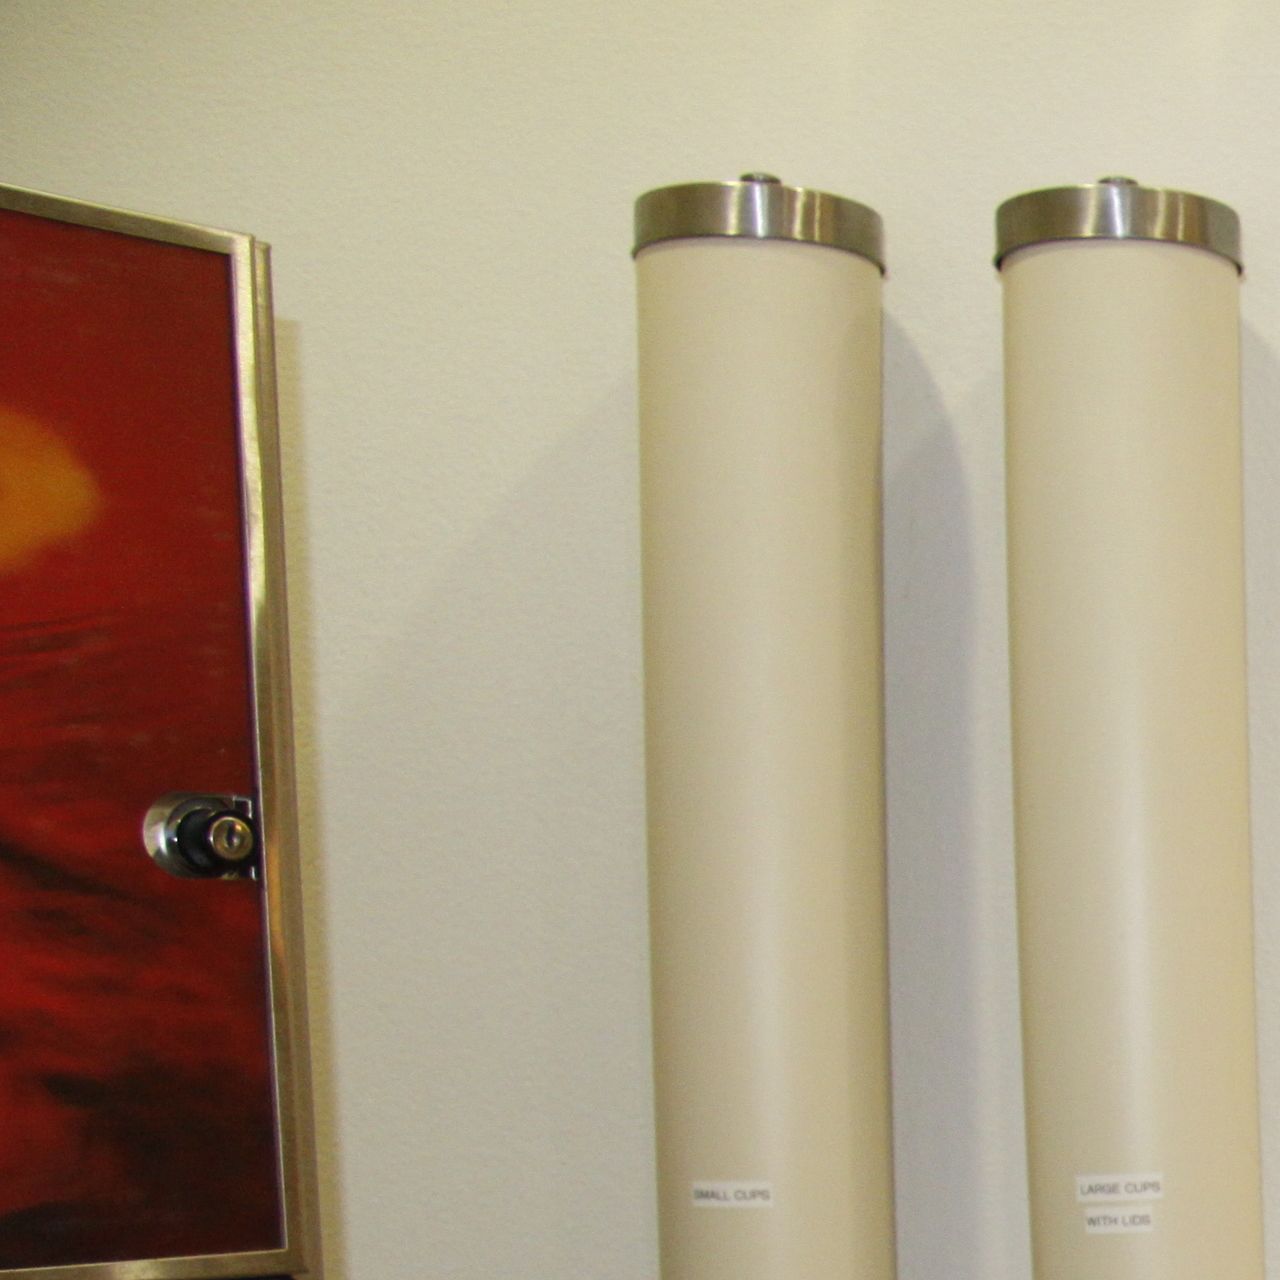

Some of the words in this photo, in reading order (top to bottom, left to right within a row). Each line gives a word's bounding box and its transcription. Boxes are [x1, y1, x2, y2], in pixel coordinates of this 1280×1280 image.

[1080, 1183, 1120, 1195] LARGE
[1124, 1181, 1161, 1194] CUPS
[733, 1189, 771, 1201] CUPS
[1087, 1215, 1118, 1227] WITH
